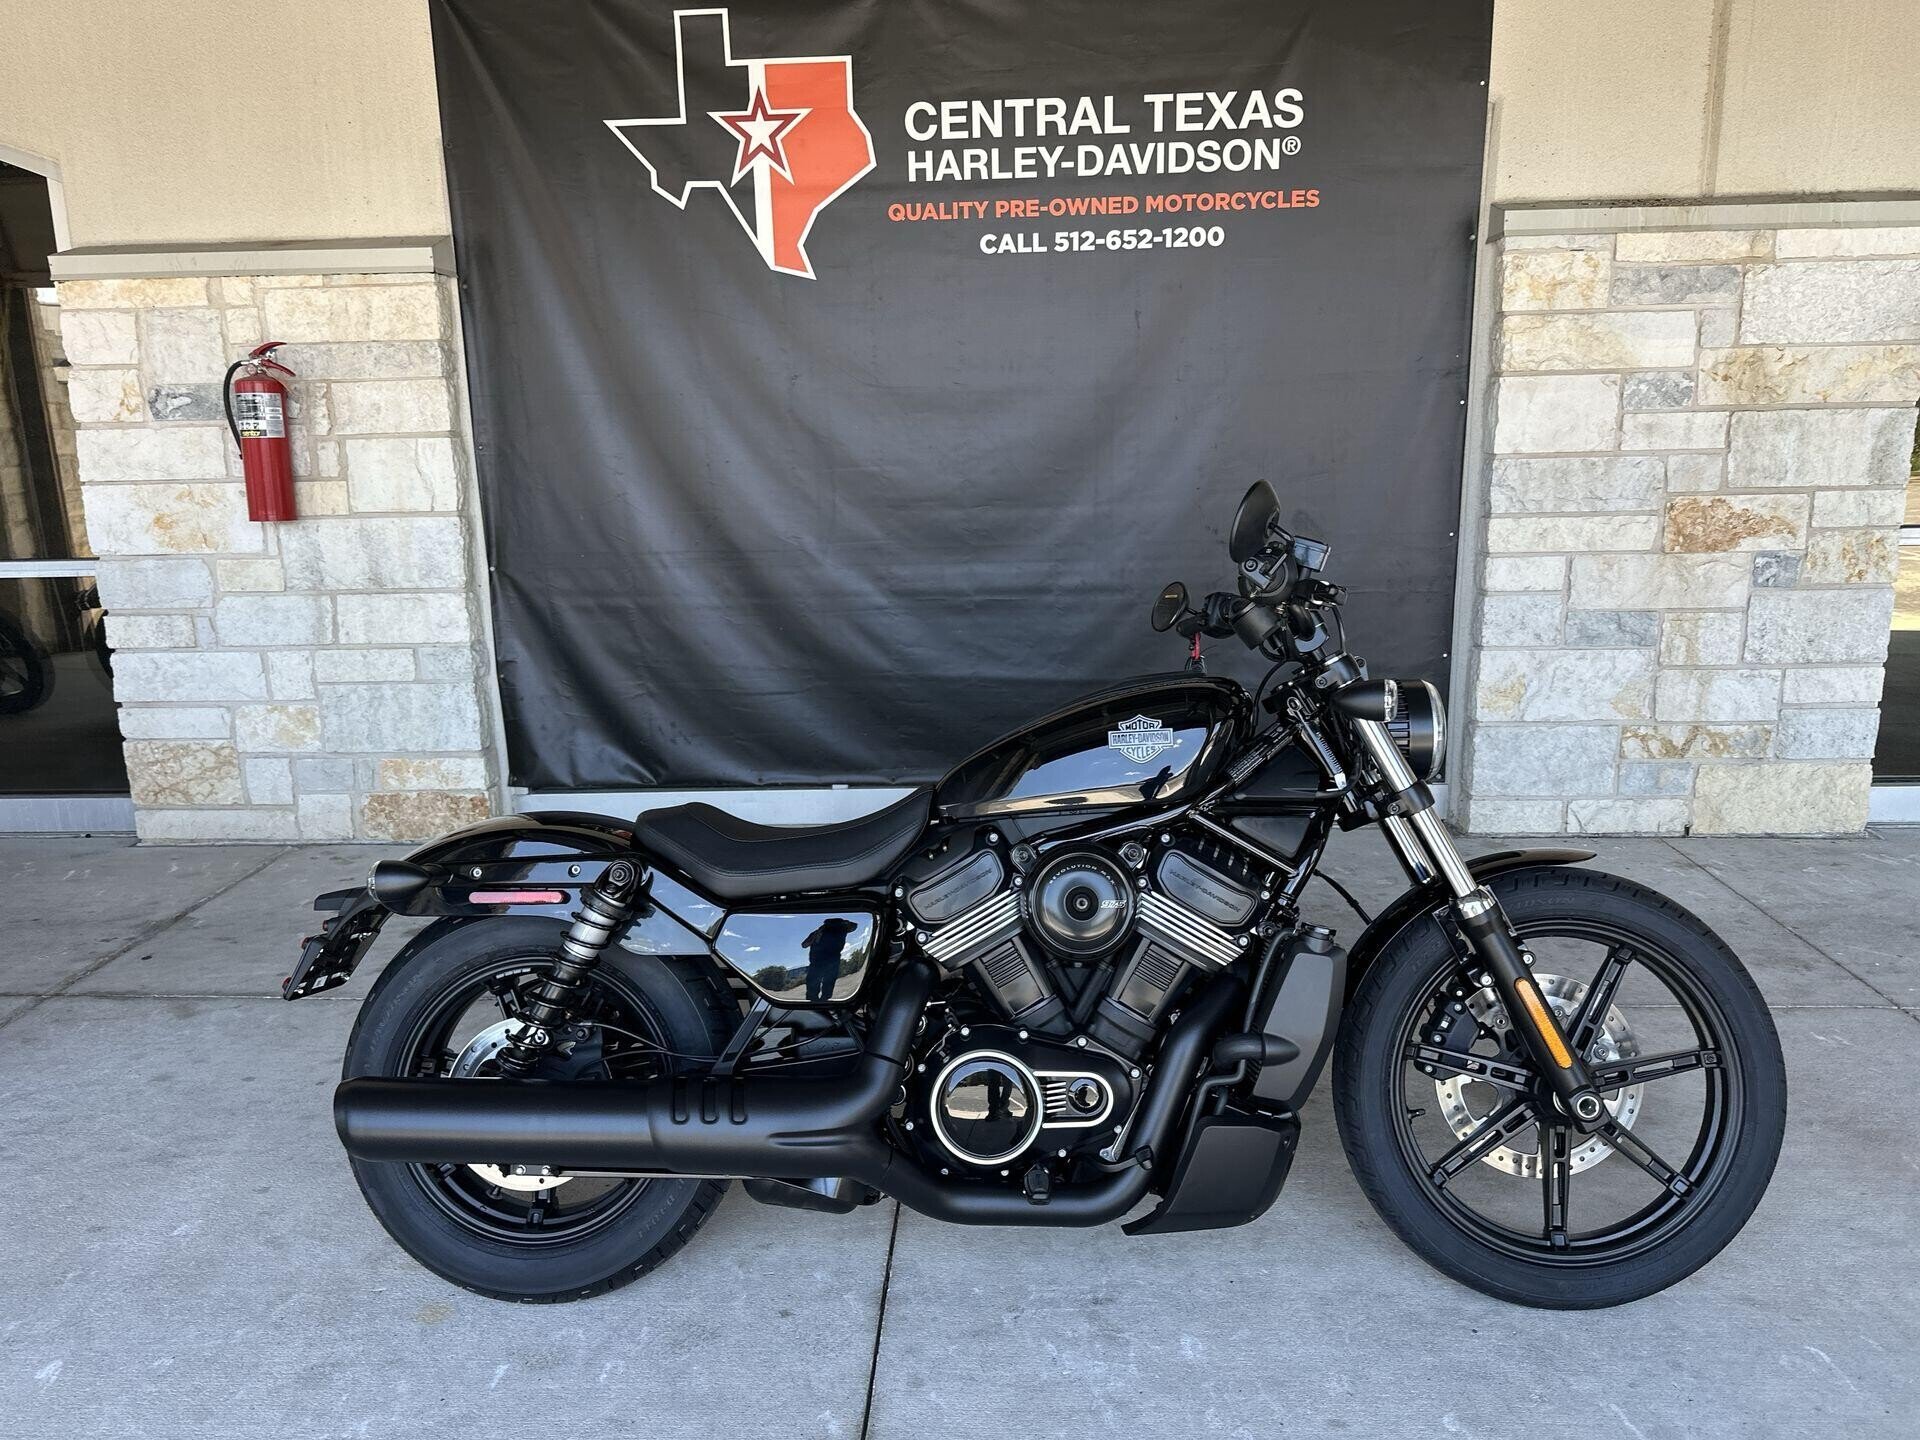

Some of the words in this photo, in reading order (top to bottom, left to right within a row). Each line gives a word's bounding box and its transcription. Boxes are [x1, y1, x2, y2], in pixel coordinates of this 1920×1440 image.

[904, 96, 1130, 142] CENTRAL
[1144, 88, 1304, 133] TEXAS
[888, 201, 989, 221] QUALITY
[994, 196, 1139, 218] PRE-OWNED
[1145, 189, 1320, 213] MOTORCYCLES
[979, 232, 1047, 254] CALL
[1053, 225, 1225, 252] 512-652-1200
[1125, 720, 1155, 730] MOTOR
[1112, 731, 1169, 745] HARLEY-DAVIDSON
[1126, 745, 1156, 759] CYCLES
